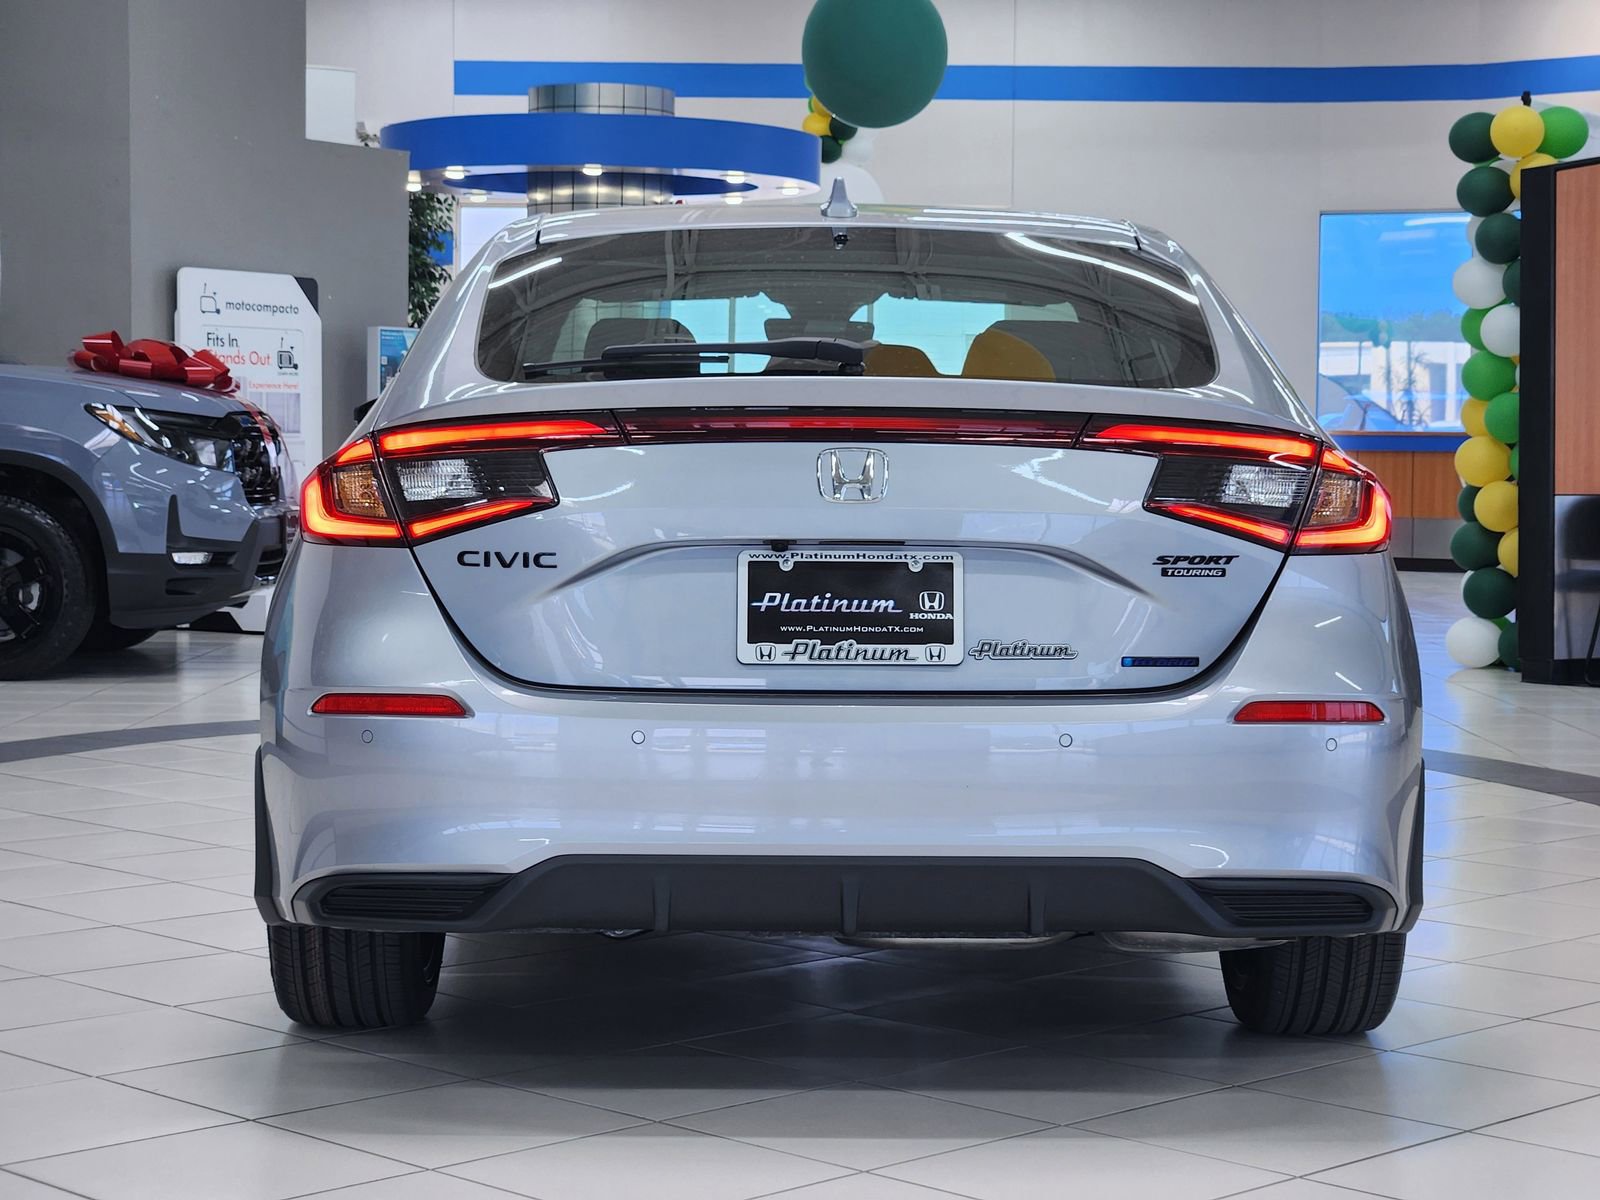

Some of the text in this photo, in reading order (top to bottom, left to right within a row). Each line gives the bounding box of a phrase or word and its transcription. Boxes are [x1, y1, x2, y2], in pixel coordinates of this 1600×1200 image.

[225, 301, 300, 316] motocompacto
[206, 332, 225, 347] Fits
[457, 551, 558, 568] CIVIC
[749, 552, 954, 561] www.PlatinumHondatx.com
[1152, 555, 1240, 565] SPORT
[751, 592, 904, 613] Platinum
[909, 612, 954, 620] HONDA
[782, 640, 920, 662] Platinum
[969, 640, 1078, 660] Platinum
